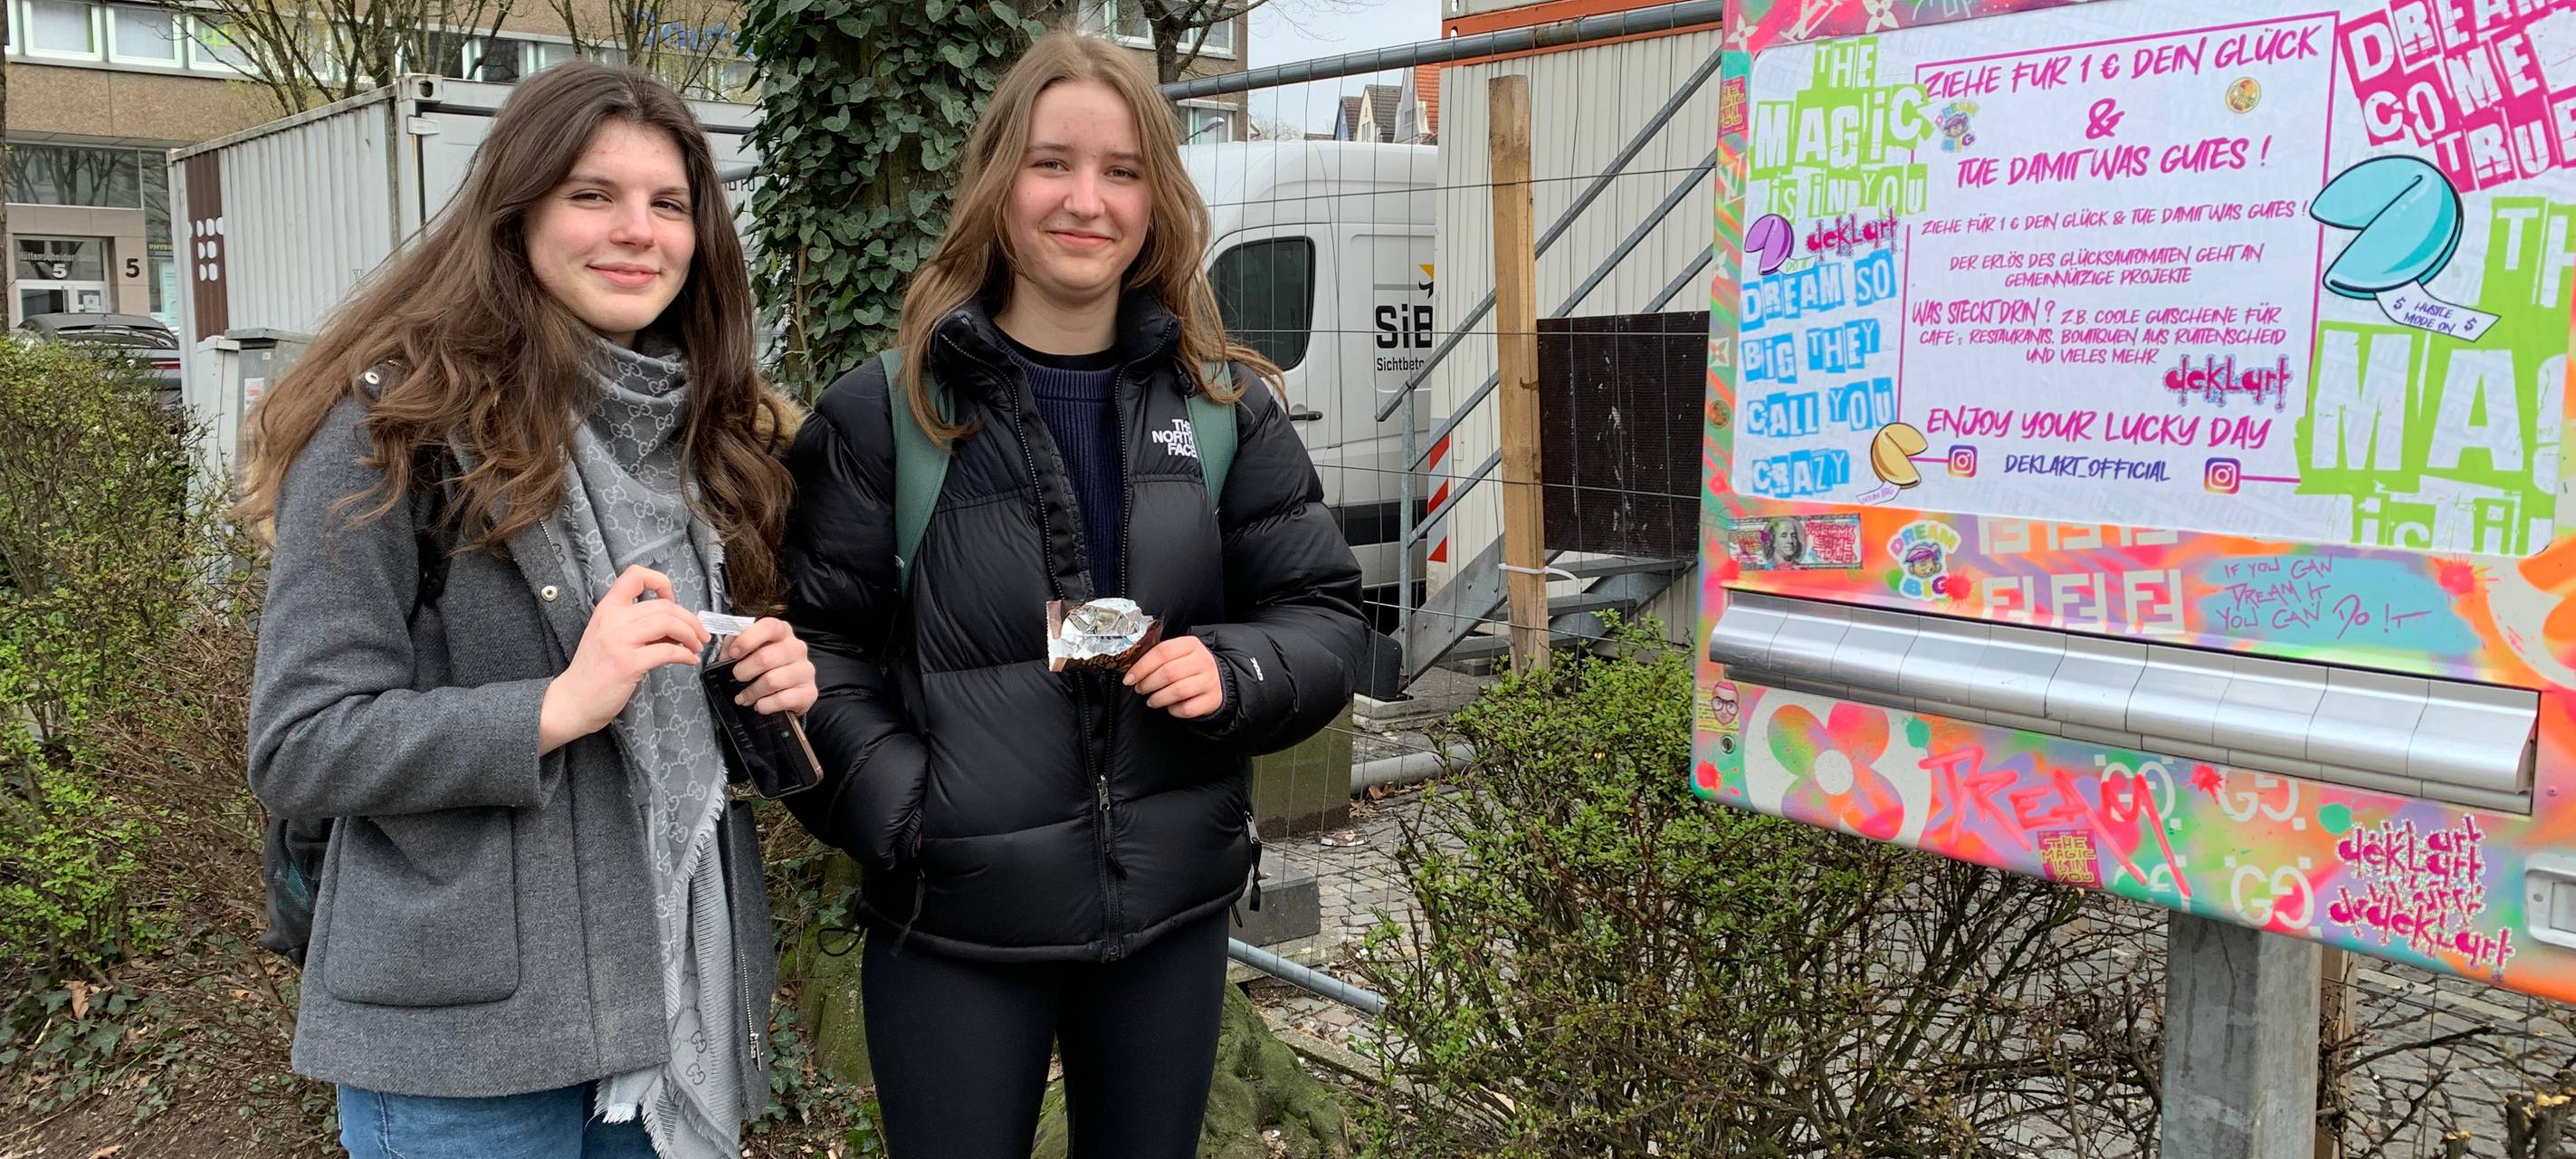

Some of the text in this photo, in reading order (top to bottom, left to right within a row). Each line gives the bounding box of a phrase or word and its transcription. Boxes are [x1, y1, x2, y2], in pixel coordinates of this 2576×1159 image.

[1818, 44, 1875, 89] THE
[1923, 65, 2002, 98] ZIEHE
[2081, 54, 2093, 83] 1
[2100, 53, 2121, 80] €
[2132, 36, 2208, 79] DEIN
[2215, 24, 2322, 68] GLÜCK
[2363, 34, 2539, 139] COME
[2085, 98, 2125, 139] &
[1958, 135, 2272, 188] TUE DAMIT WAS GUTES !
[1863, 173, 1924, 216] YOU
[1922, 200, 2308, 235] ZIEHE FÜR 1 € DEIN GLÜCK & TUE DAMIT WAS GUTES !
[52, 263, 68, 279] 5
[126, 258, 139, 278] 5
[1950, 243, 2265, 271] DER ERLÖS DES GLÜCKSAUTOMATEN GEHT AN
[1743, 258, 1890, 323] DREAM SO
[2005, 267, 2192, 288] GEMEINNÜTZIGE PROJEKTE
[1912, 300, 1942, 326] WAS
[1948, 299, 2002, 325] STECKT
[1999, 297, 2040, 326] DRIN
[2045, 301, 2056, 322] ?
[2094, 309, 2140, 325] COOLE
[2146, 306, 2237, 325] GUTSCHEINE
[2245, 302, 2282, 324] FÜR
[2404, 311, 2457, 335] MODE ON
[2414, 302, 2454, 319] HUSTLE
[1810, 322, 1876, 368] THEY
[2061, 327, 2139, 345] BOUTIQUEN
[2142, 329, 2170, 344] AUS
[2026, 347, 2160, 364] UND VIELES MEHR
[1749, 389, 1893, 434] CALL YOU
[1926, 405, 2273, 449] ENJOY YOUR LUCKY DAY
[1753, 452, 1847, 495] CRAZY
[2004, 455, 2171, 482] DEKLART_OFFICIAL
[1889, 521, 1961, 557] DREAM
[2225, 553, 2333, 580] IF YOU CAN
[1903, 576, 1948, 599] BIG
[2225, 580, 2302, 612] DREAM
[2216, 607, 2259, 631] YOU
[2272, 600, 2321, 630] CAN
[2041, 848, 2096, 863] MAGIC
[2045, 836, 2087, 849] THE
